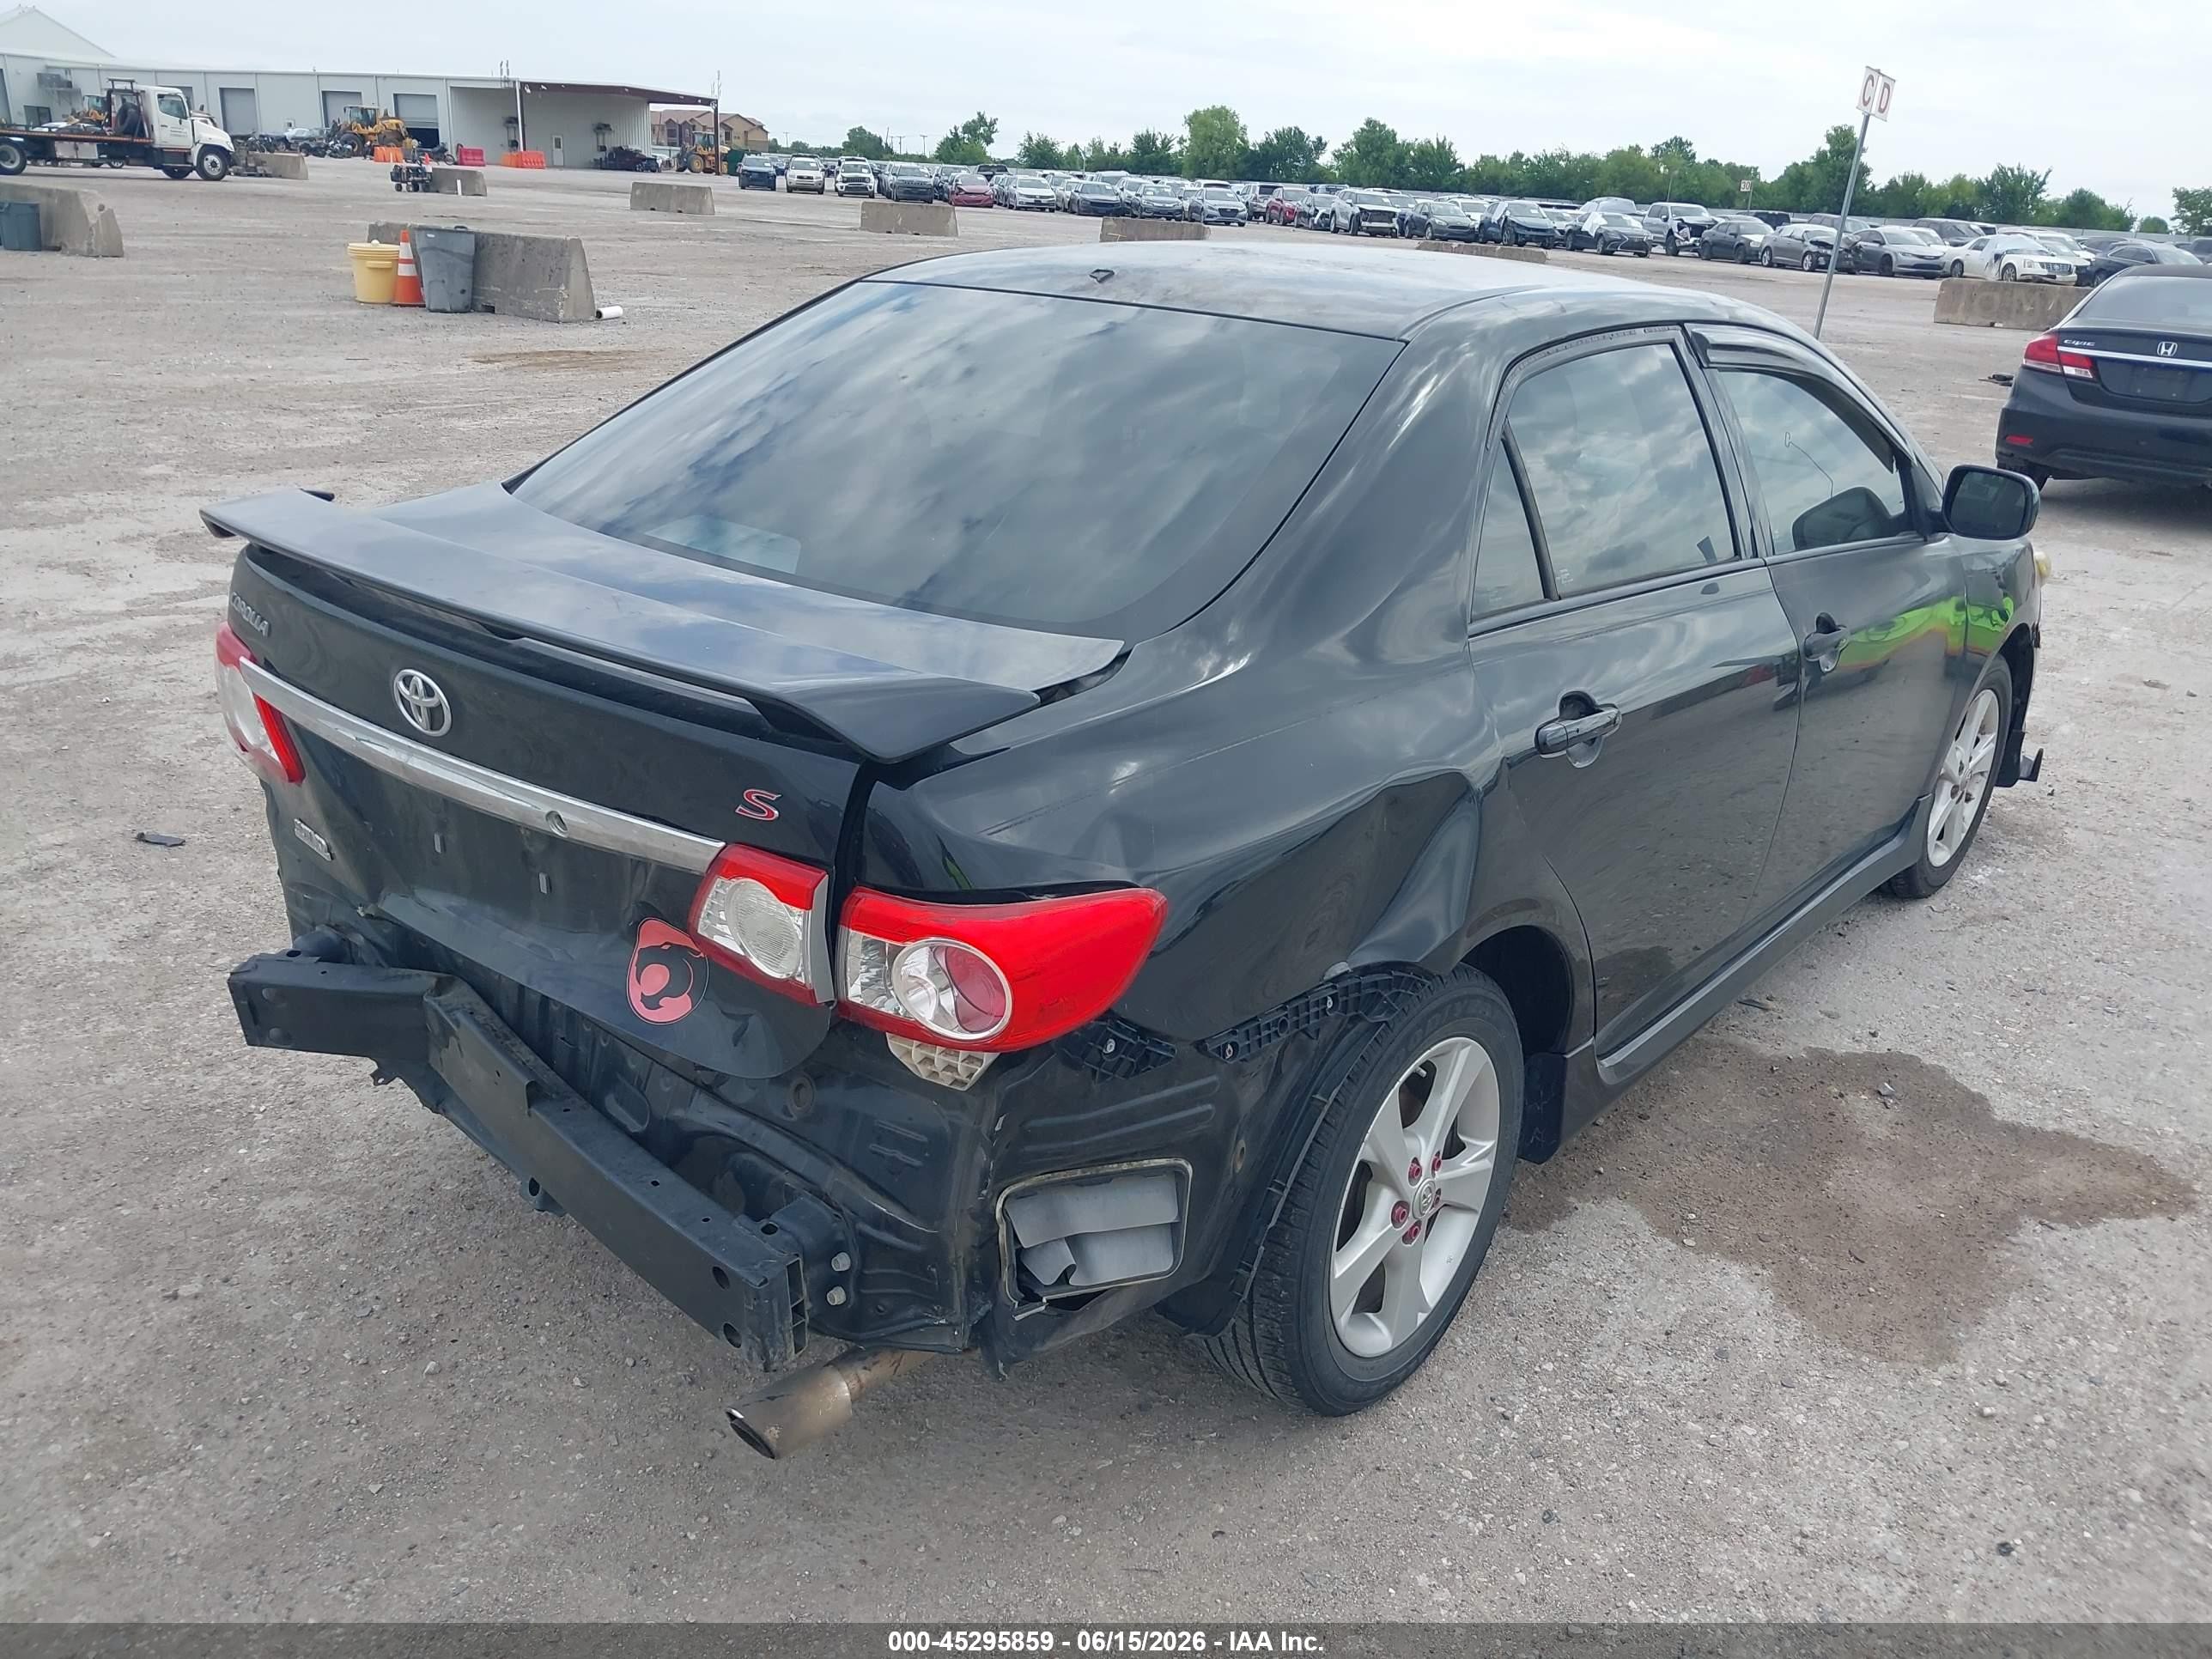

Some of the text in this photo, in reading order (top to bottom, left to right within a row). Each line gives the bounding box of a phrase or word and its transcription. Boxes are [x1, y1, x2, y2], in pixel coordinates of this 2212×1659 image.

[1863, 75, 1890, 113] C D
[231, 591, 269, 638] COROLLA
[735, 789, 781, 820] S
